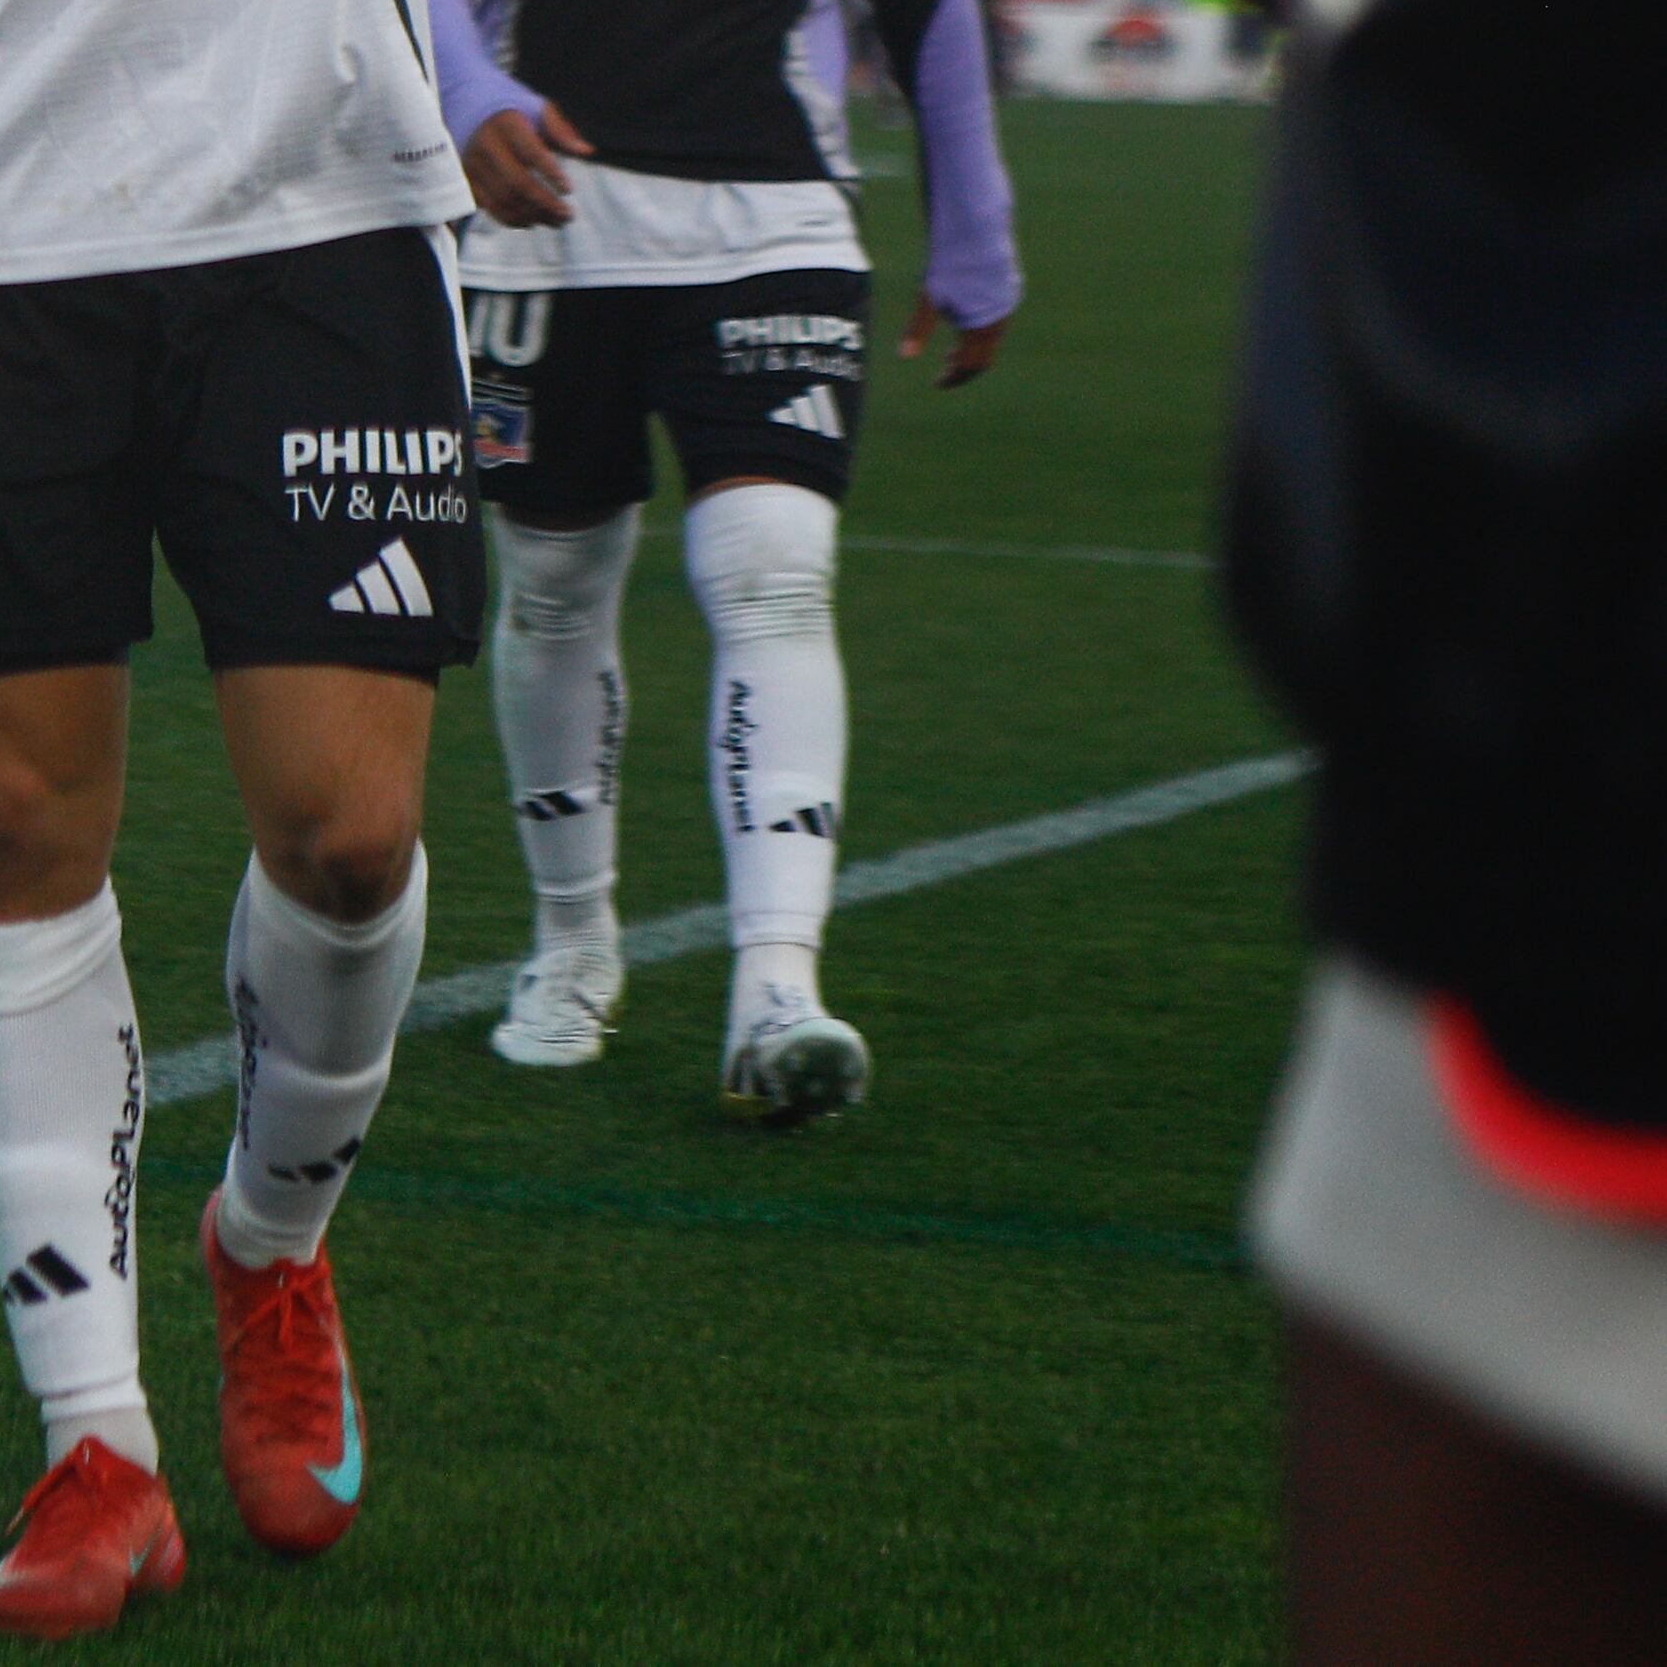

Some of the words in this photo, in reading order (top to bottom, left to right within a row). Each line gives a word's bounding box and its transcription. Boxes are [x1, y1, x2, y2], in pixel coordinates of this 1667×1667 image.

[718, 314, 862, 351] PHILIPS
[284, 483, 336, 522] TV
[348, 483, 377, 521] &
